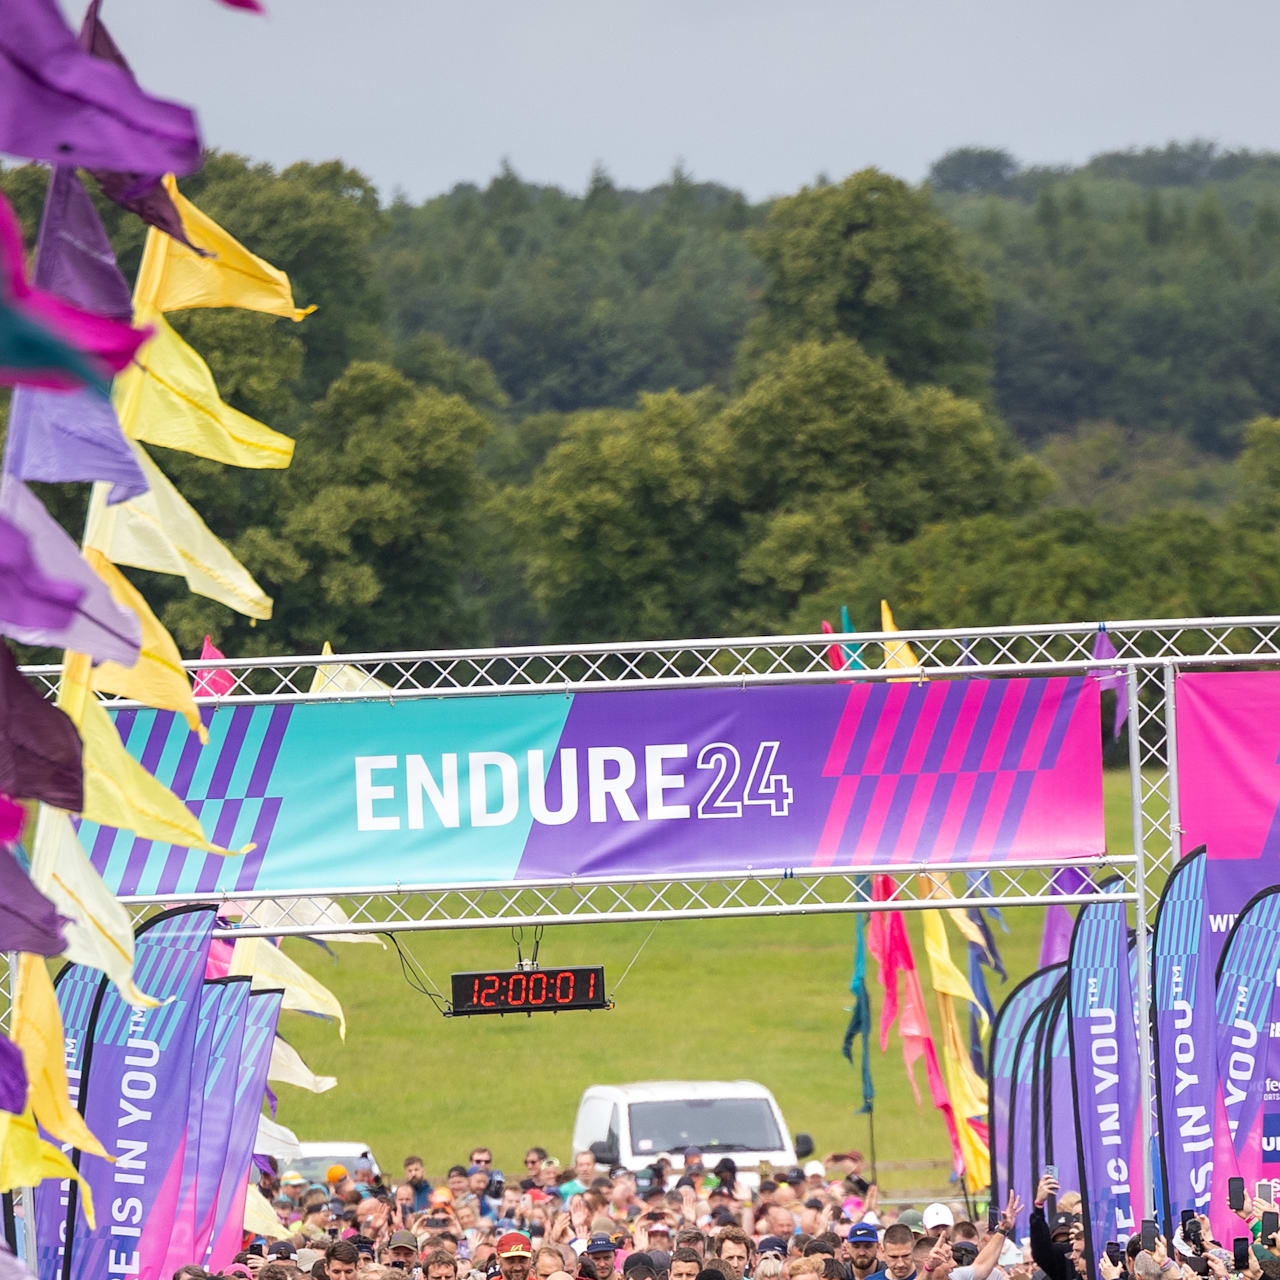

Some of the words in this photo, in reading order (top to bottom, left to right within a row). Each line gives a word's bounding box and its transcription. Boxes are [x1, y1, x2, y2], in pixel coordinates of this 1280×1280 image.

[354, 741, 793, 831] ENDURE24
[473, 971, 596, 1006] 12:00:01
[1097, 1103, 1121, 1146] IN
[1177, 1105, 1214, 1153] IN
[114, 1139, 148, 1184] IN
[1190, 1162, 1214, 1207] IS
[111, 1196, 142, 1237] IS
